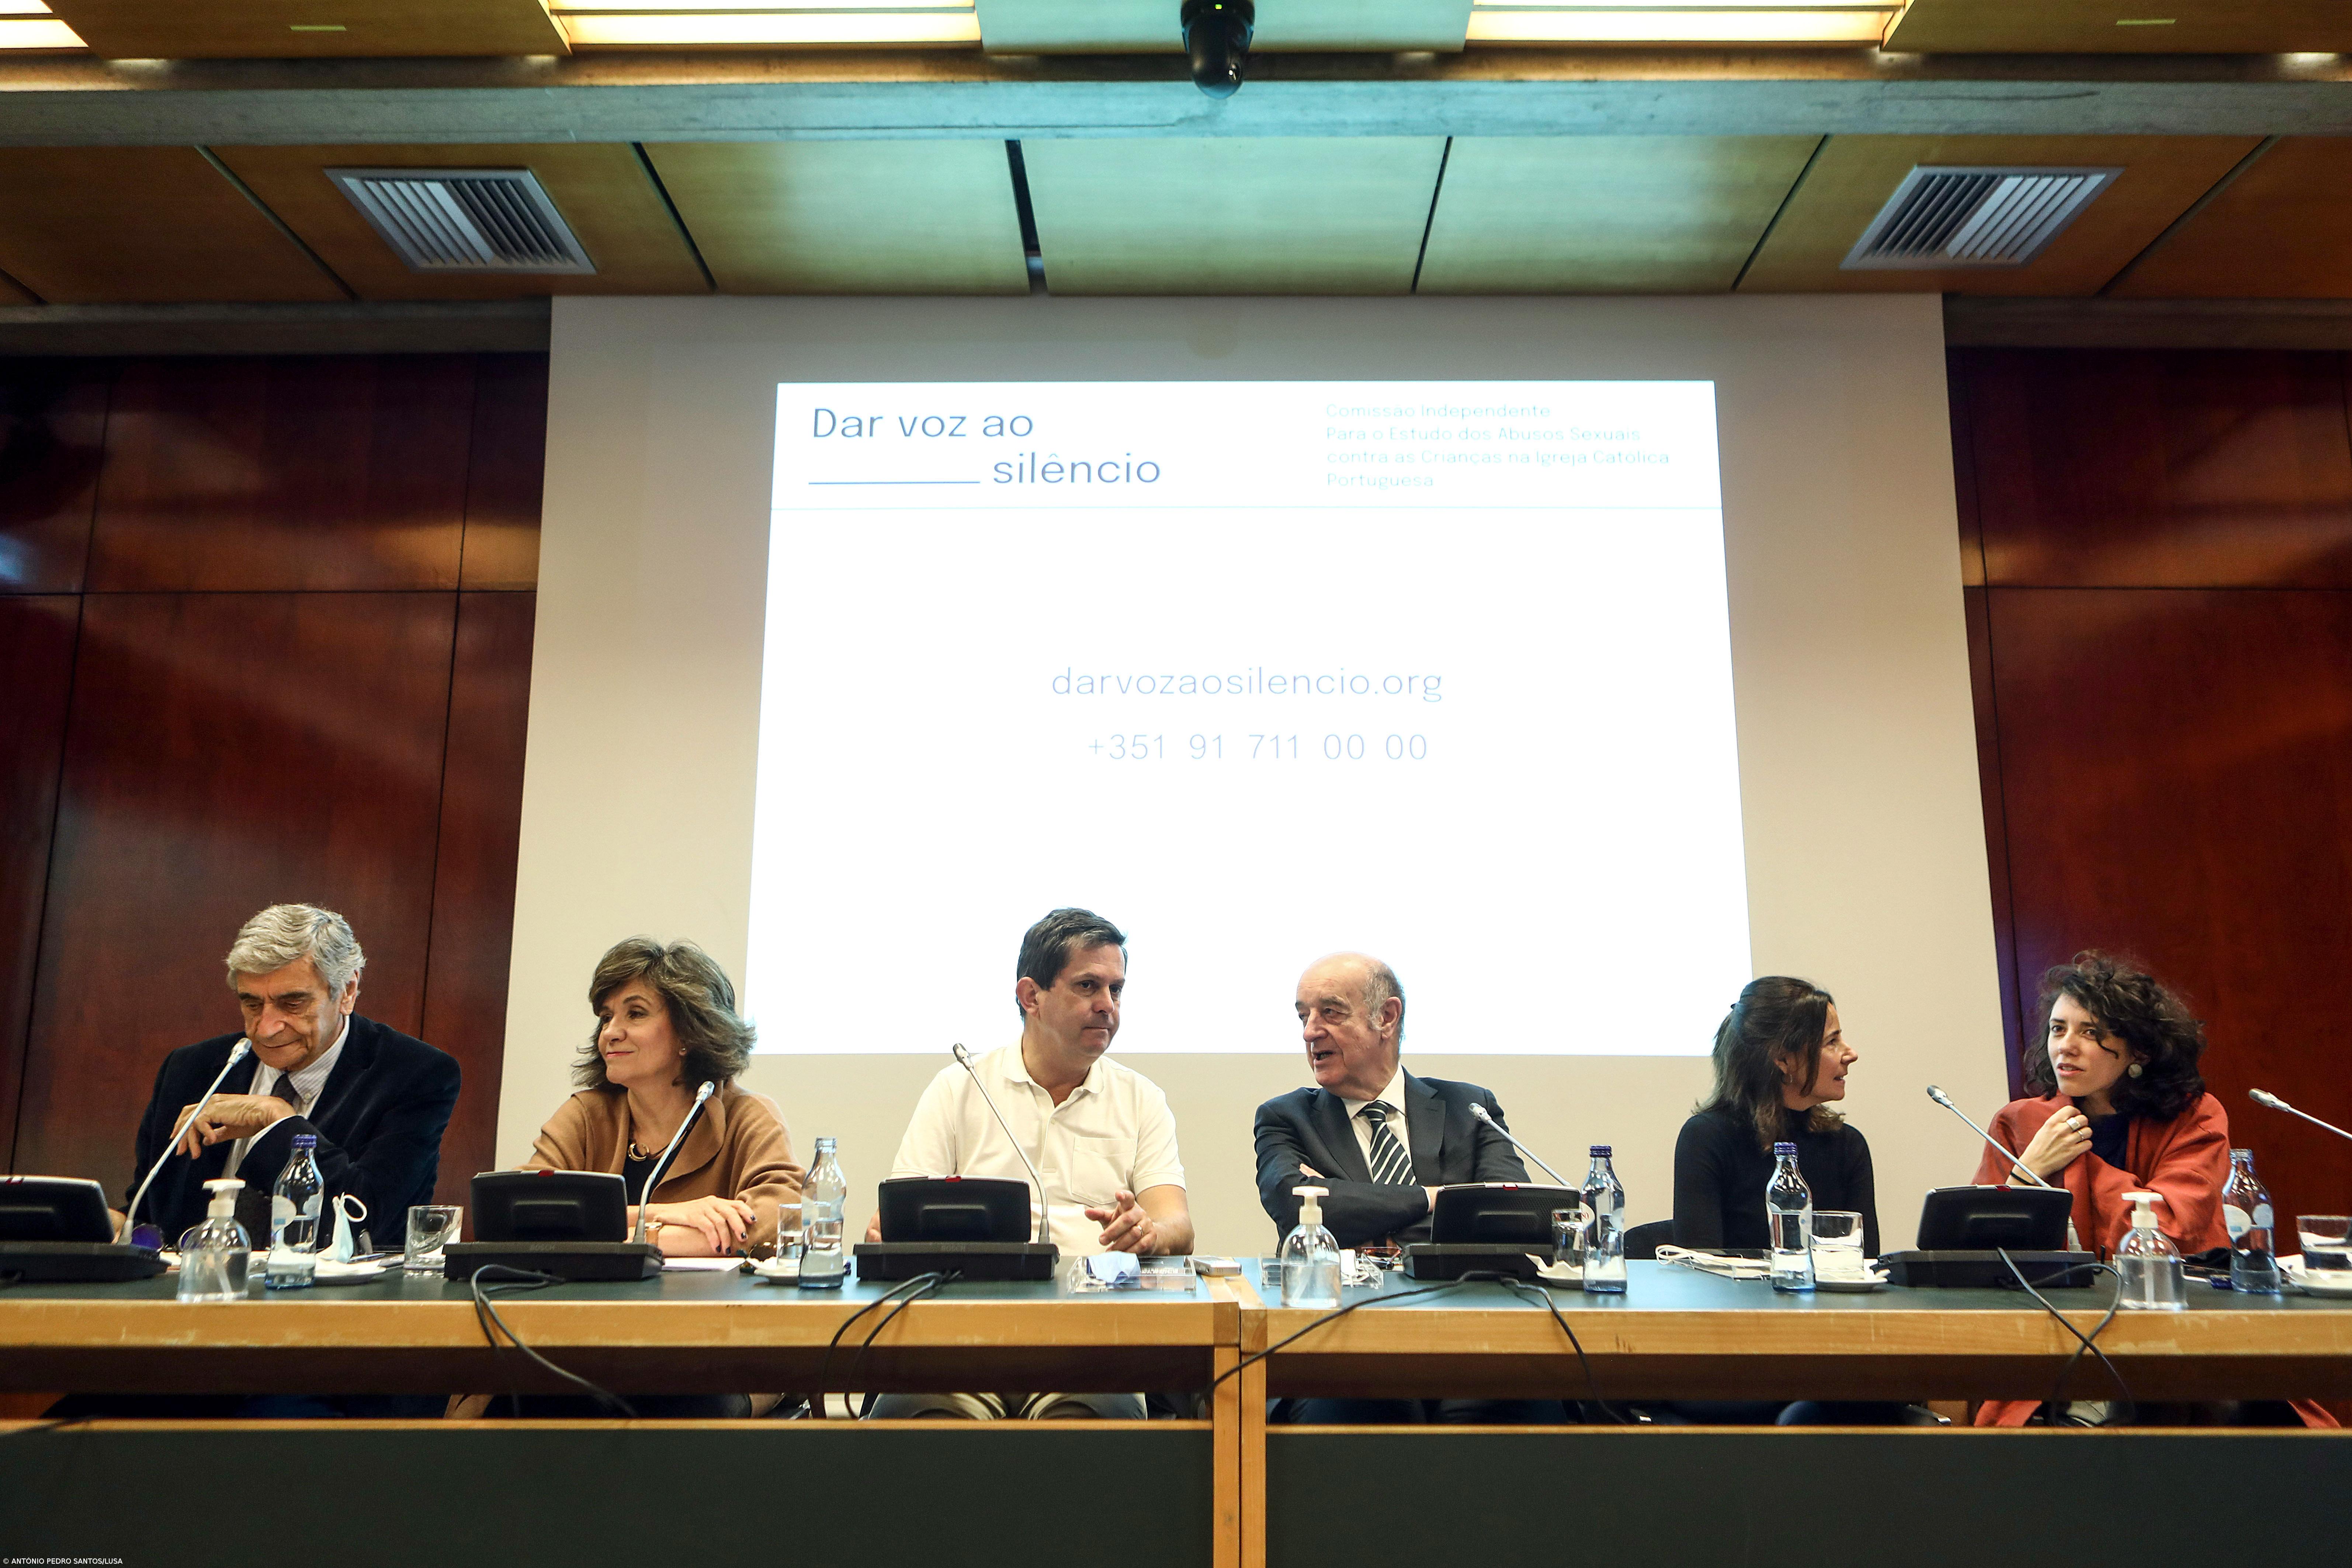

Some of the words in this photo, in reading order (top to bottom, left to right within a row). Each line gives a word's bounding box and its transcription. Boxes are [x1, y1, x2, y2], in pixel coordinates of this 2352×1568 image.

[1326, 403, 1415, 417] Comissão
[1422, 404, 1550, 420] Independente
[814, 408, 884, 438] Dar
[898, 416, 967, 437] voz
[983, 416, 1033, 437] ao
[1327, 427, 1366, 440] Para
[1373, 430, 1384, 440] o
[1390, 427, 1452, 440] Estudo
[1458, 427, 1491, 440] dos
[1498, 427, 1564, 440] Abusos
[1570, 427, 1640, 441] Sexuais
[993, 452, 1160, 483] silêncio
[1327, 451, 1388, 463] contra
[1395, 454, 1415, 463] as
[1422, 450, 1502, 465] Crianças
[1509, 454, 1530, 464] na
[1536, 451, 1587, 467] Igreja
[1593, 450, 1669, 464] Católica
[1328, 473, 1434, 490] Portuguesa
[1052, 666, 1442, 703] darvozaosilencio.org
[1089, 734, 1162, 759] +351
[1190, 734, 1221, 759] 91
[1249, 735, 1297, 759] 711
[1324, 734, 1364, 760] 00
[1386, 734, 1427, 760] 00
